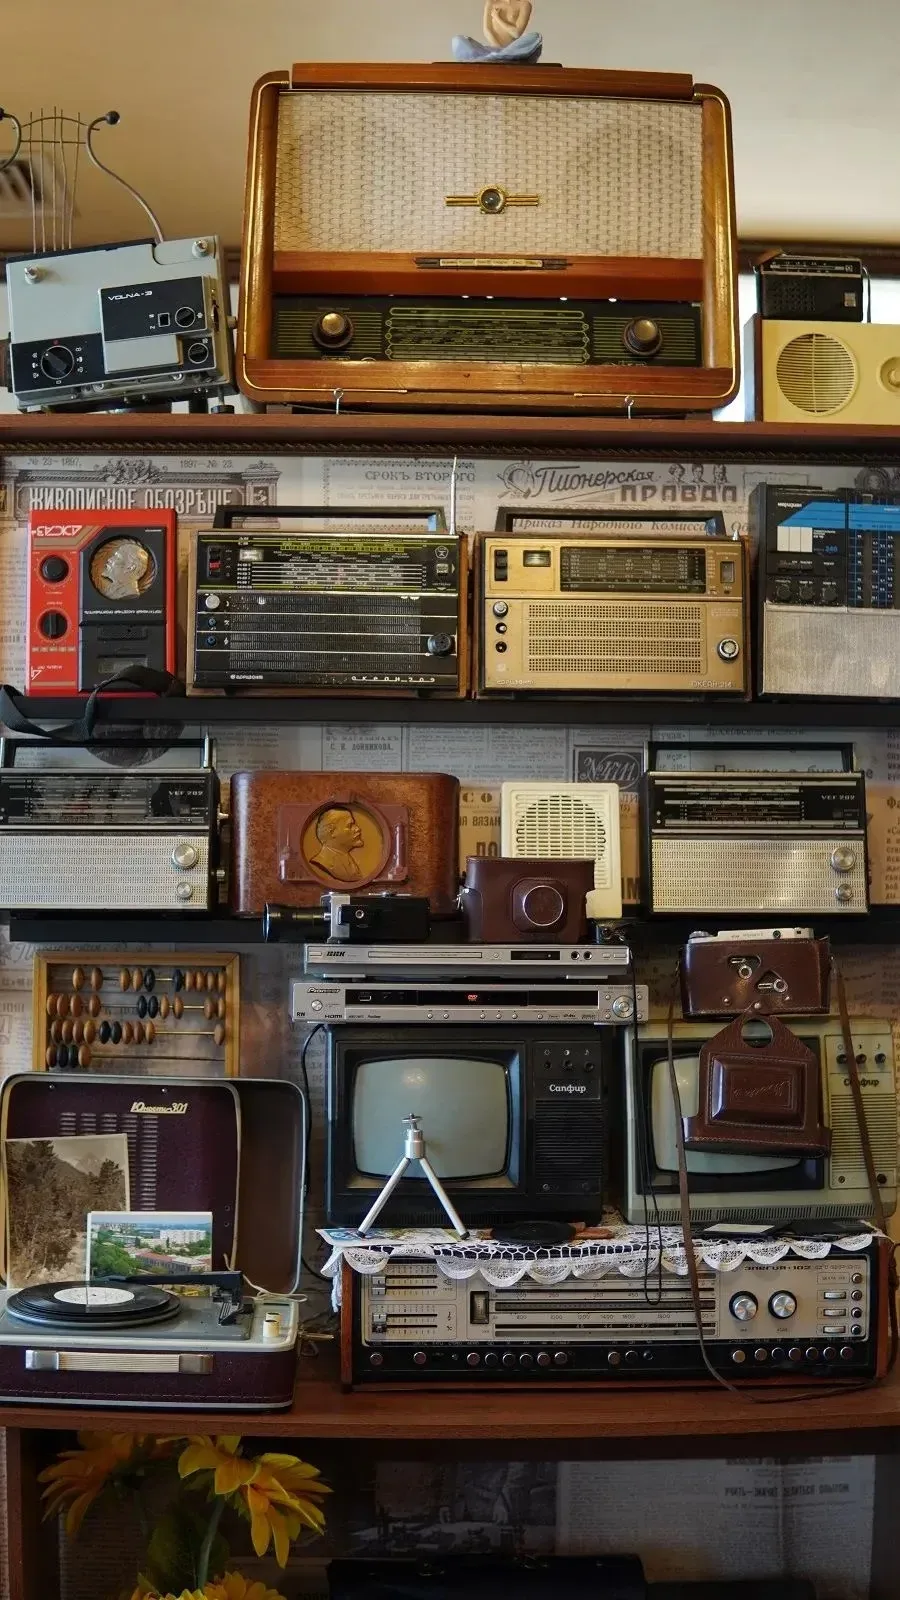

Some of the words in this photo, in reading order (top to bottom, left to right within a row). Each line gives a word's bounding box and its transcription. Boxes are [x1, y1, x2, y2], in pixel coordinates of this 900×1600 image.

[108, 290, 153, 301] VOLNA-3
[364, 470, 411, 482] СРОКЪ
[549, 1083, 587, 1094] Сапфир
